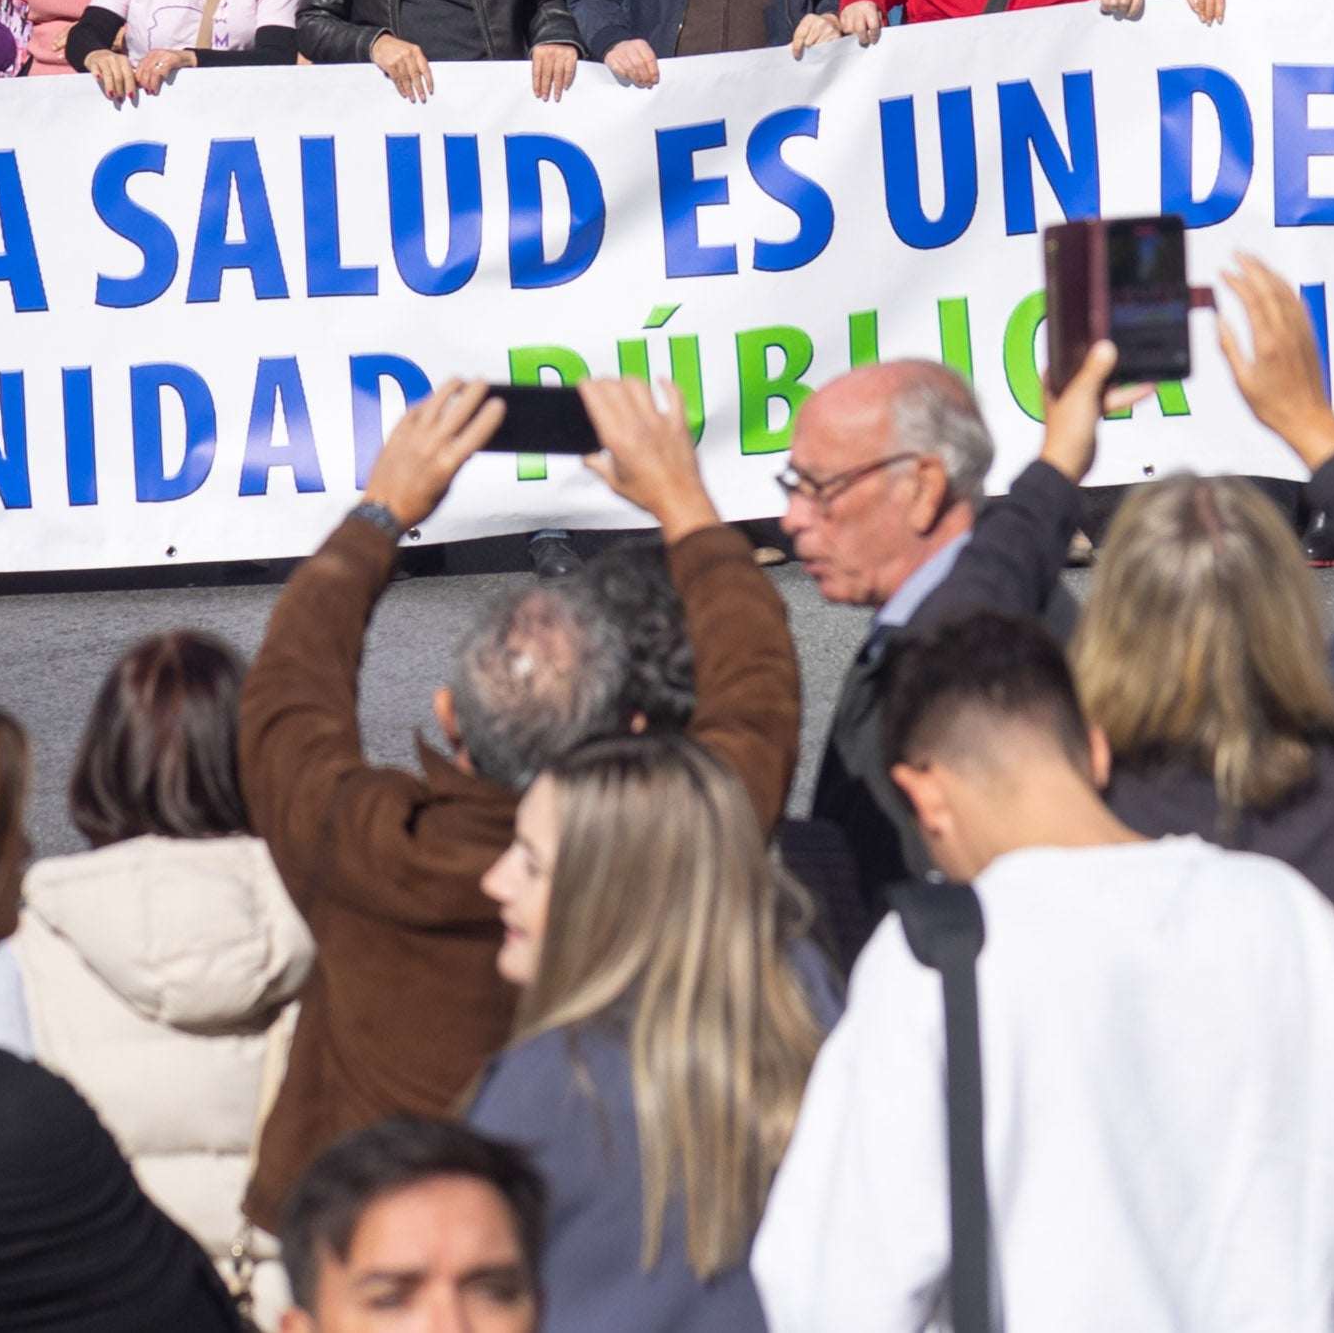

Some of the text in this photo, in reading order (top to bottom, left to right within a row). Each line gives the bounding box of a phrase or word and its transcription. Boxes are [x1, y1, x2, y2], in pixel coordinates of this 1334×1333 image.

[95, 133, 606, 310] SALUD
[661, 107, 835, 282] ES
[880, 70, 1102, 250] UN
